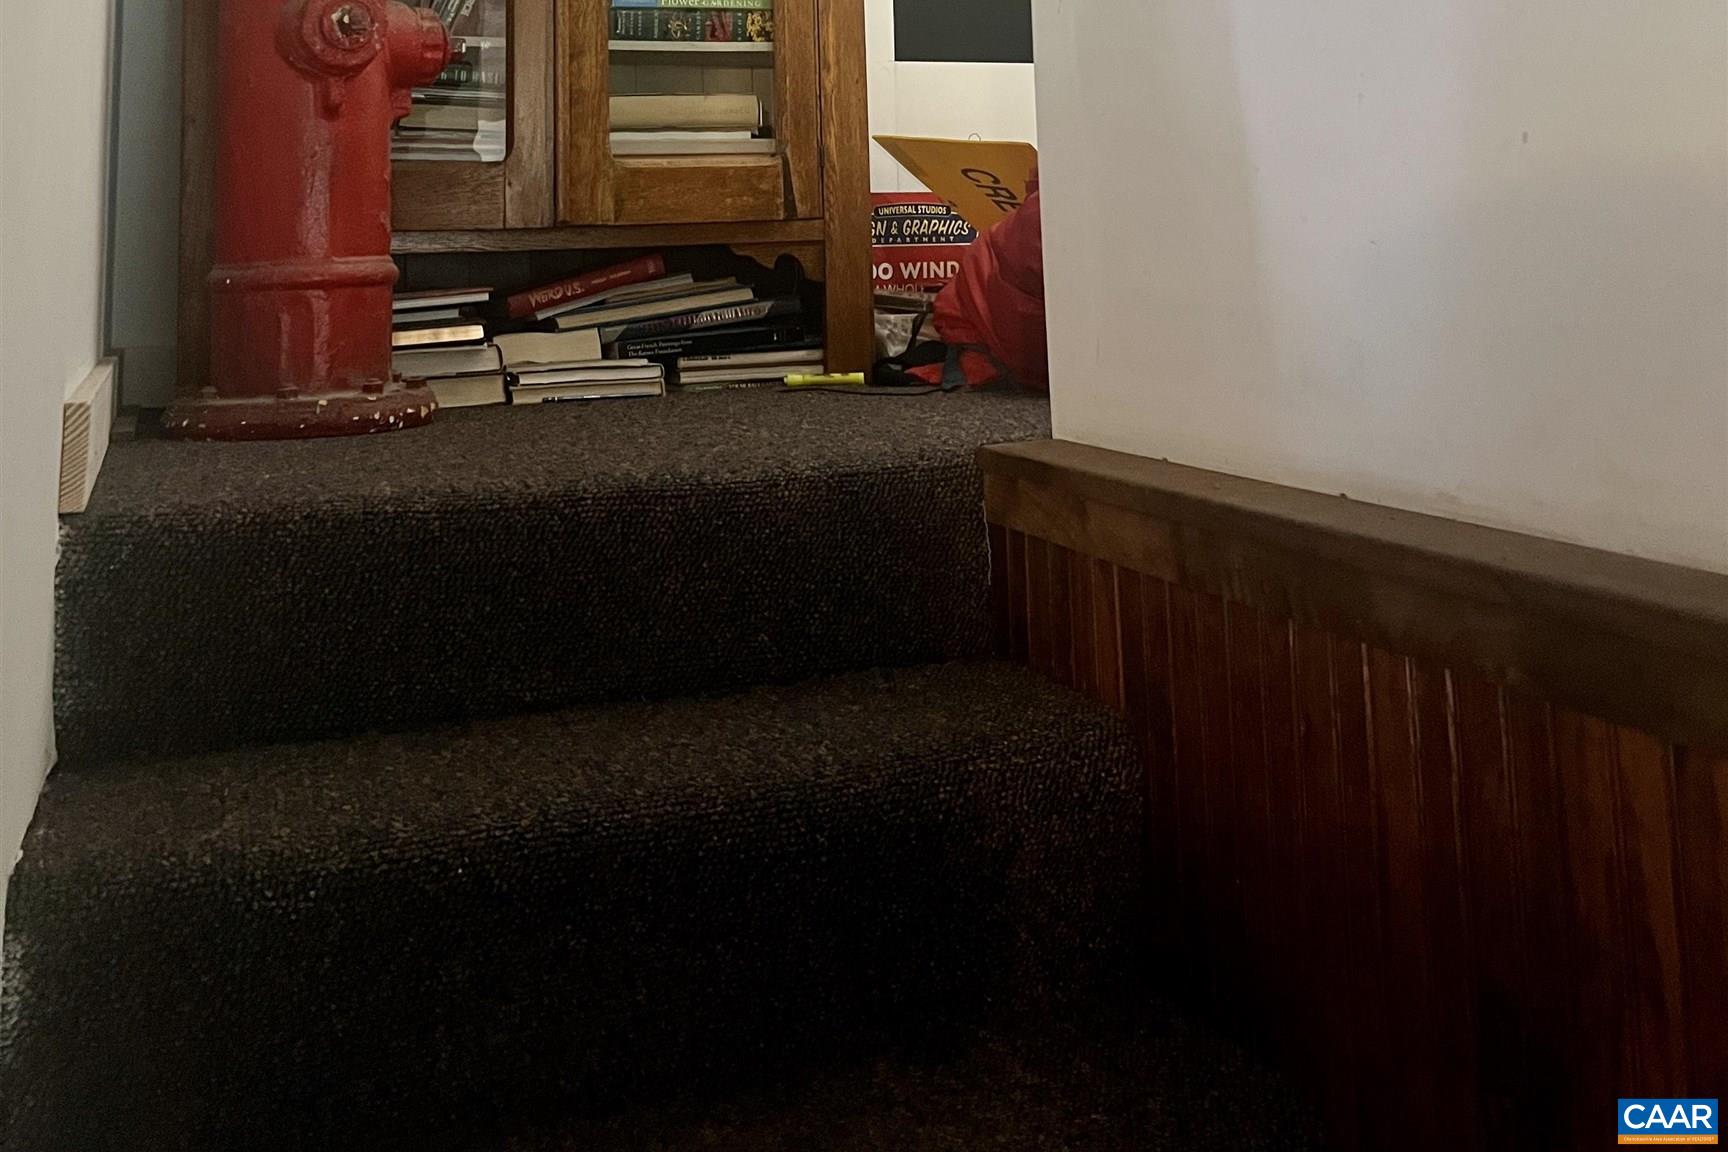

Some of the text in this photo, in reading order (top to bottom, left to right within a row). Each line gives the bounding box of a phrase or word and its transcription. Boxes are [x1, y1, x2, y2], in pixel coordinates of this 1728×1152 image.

[878, 204, 948, 216] UNIVERSAL STUDIOS
[890, 220, 900, 236] &
[902, 218, 972, 236] GRAPHICS
[872, 236, 955, 245] DEPARTMENT
